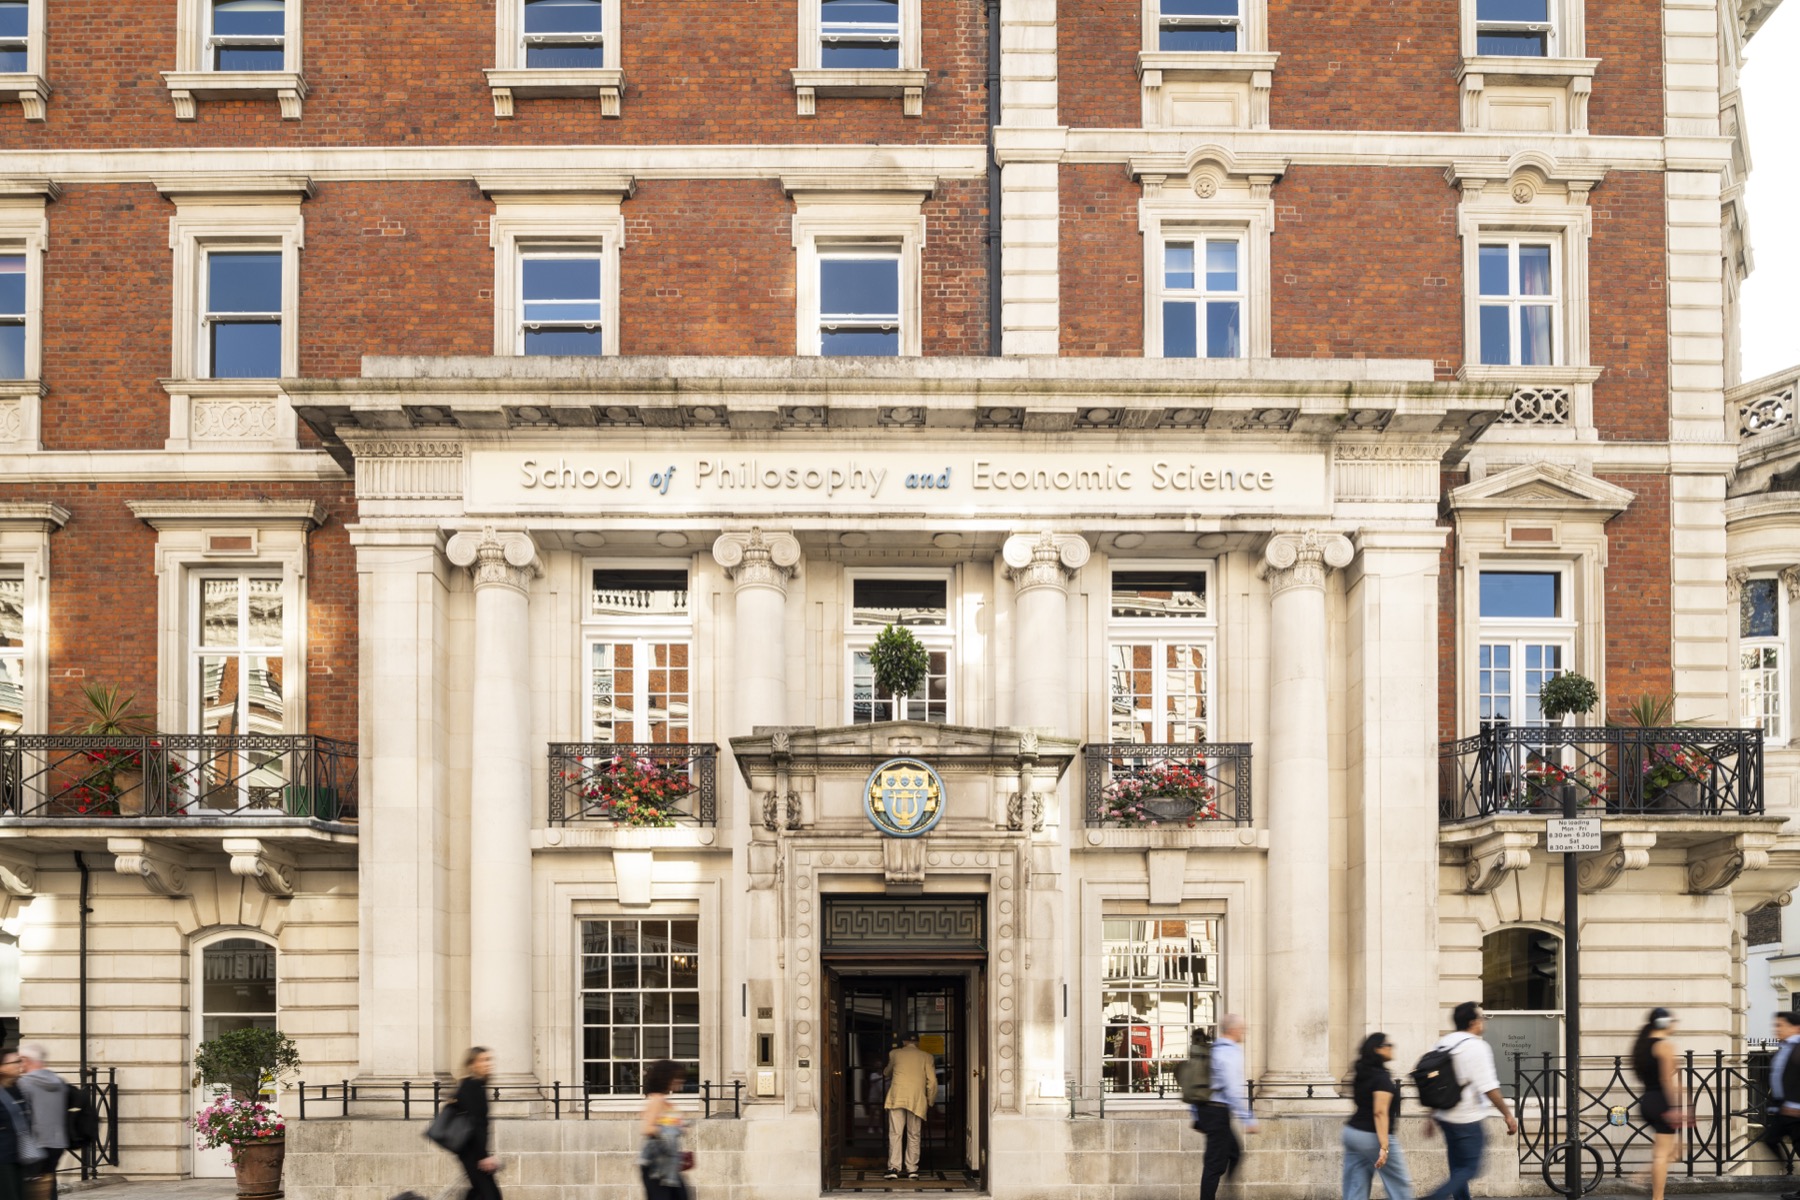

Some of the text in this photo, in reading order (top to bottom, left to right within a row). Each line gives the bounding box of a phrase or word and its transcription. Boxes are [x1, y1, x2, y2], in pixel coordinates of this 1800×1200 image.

[520, 459, 1274, 498] School of Philosophy and Economic Science
